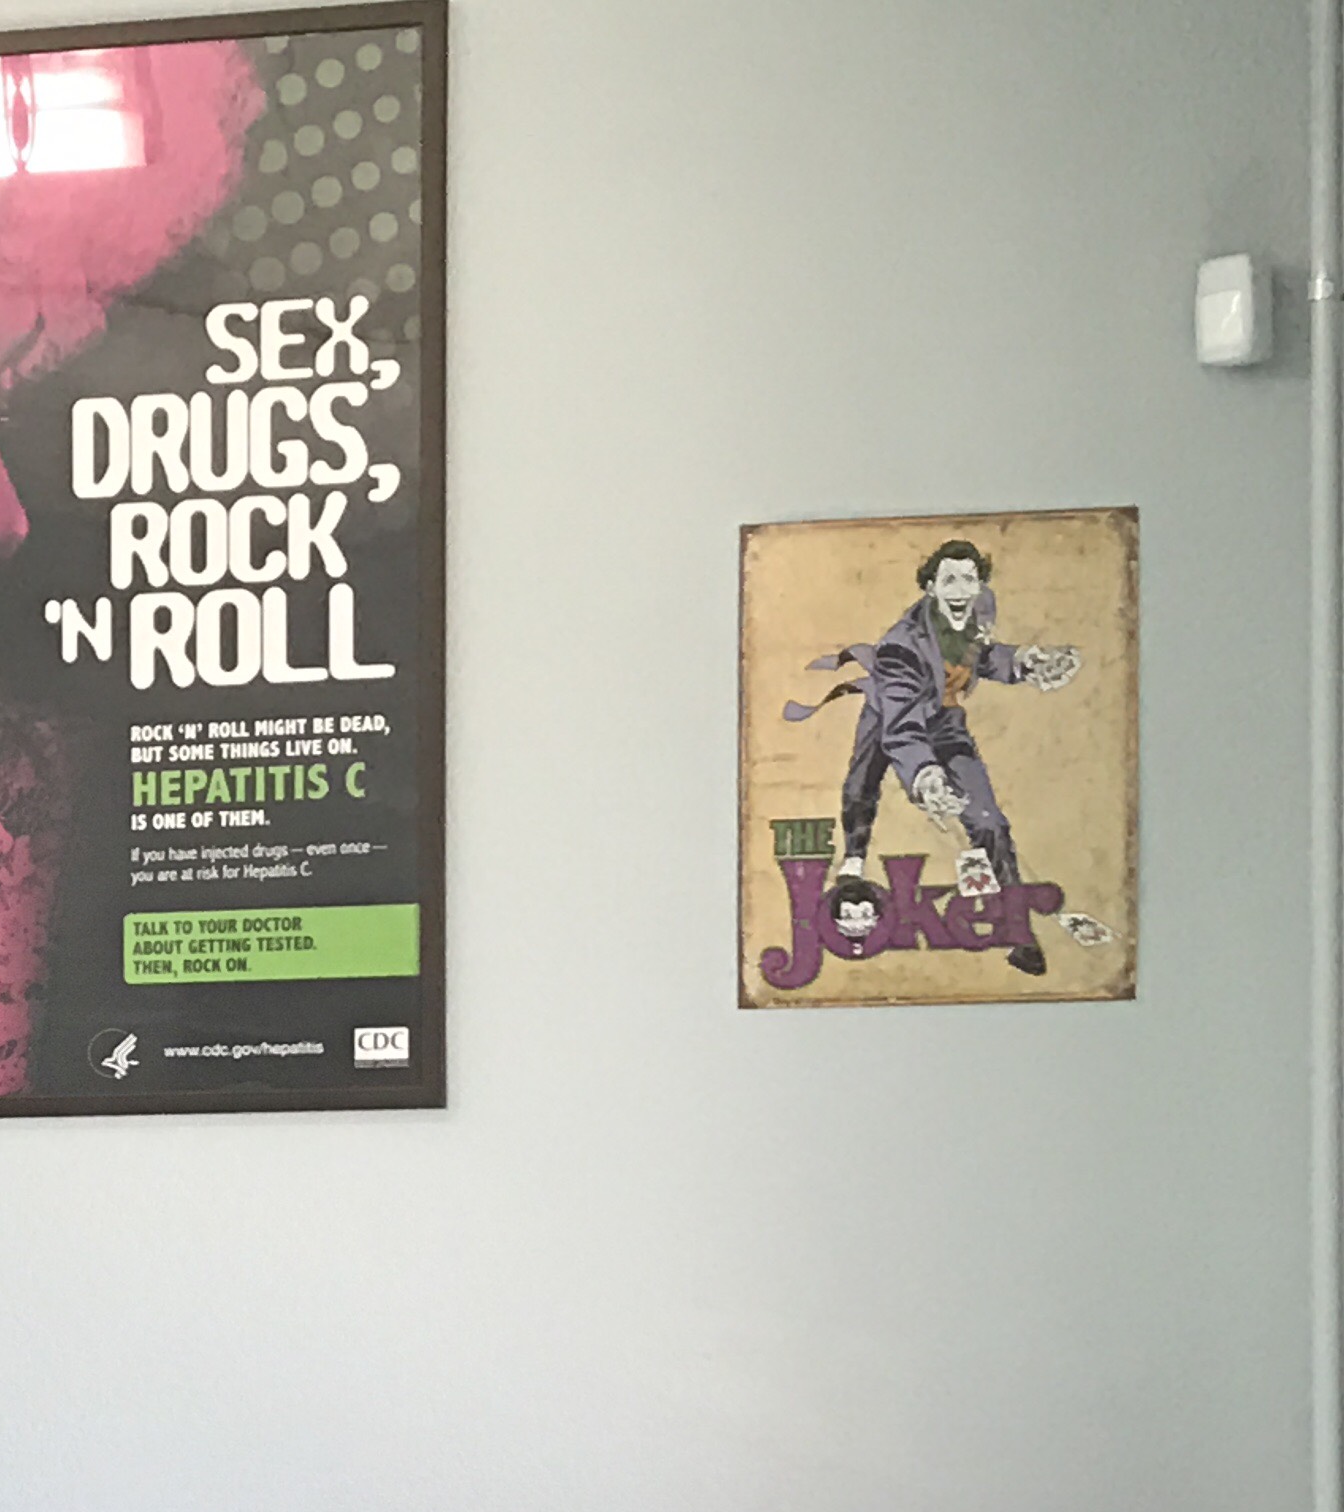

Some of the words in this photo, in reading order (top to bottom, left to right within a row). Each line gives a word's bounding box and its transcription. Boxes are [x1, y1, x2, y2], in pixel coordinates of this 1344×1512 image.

[206, 295, 400, 390] SEX,
[72, 381, 401, 502] DRUGS,
[110, 491, 348, 590] ROCK
[130, 583, 396, 690] ROLL
[130, 724, 173, 742] ROCK
[208, 721, 249, 739] ROLL
[255, 718, 307, 737] MIGHT
[313, 717, 334, 734] BE
[340, 715, 391, 736] DEAD,
[131, 746, 162, 763] BUT
[169, 744, 214, 761] SOME
[220, 741, 280, 760] THINGS
[286, 740, 322, 757] LIVE
[328, 738, 358, 755] ON.
[132, 763, 329, 807] HEPATITIS
[345, 762, 366, 798] C
[131, 814, 147, 830] IS
[152, 813, 186, 829] ONE
[191, 811, 213, 828] OF
[219, 809, 271, 827] THEM.
[770, 818, 836, 855] THE
[142, 850, 166, 866] you
[168, 846, 198, 861] have
[201, 844, 249, 862] injected
[252, 843, 289, 861] drugs
[306, 843, 338, 857] even
[130, 870, 154, 887] you
[157, 869, 178, 882] are
[180, 867, 194, 881] at
[196, 865, 219, 881] risk
[222, 864, 241, 879] for
[243, 862, 298, 882] Hepatitis
[133, 921, 168, 936] TALK
[173, 920, 193, 935] TO
[198, 918, 238, 934] YOUR
[243, 916, 302, 933] DOCTOR
[759, 854, 1064, 990] Joker
[132, 940, 182, 956] ABOUT
[188, 937, 251, 954] GETTING
[256, 935, 317, 952] TESTED.
[133, 959, 178, 977] THEN,
[183, 957, 221, 973] ROCK
[164, 1040, 325, 1060] www.cdc.gov/hepatitis
[357, 1031, 405, 1051] CDC
